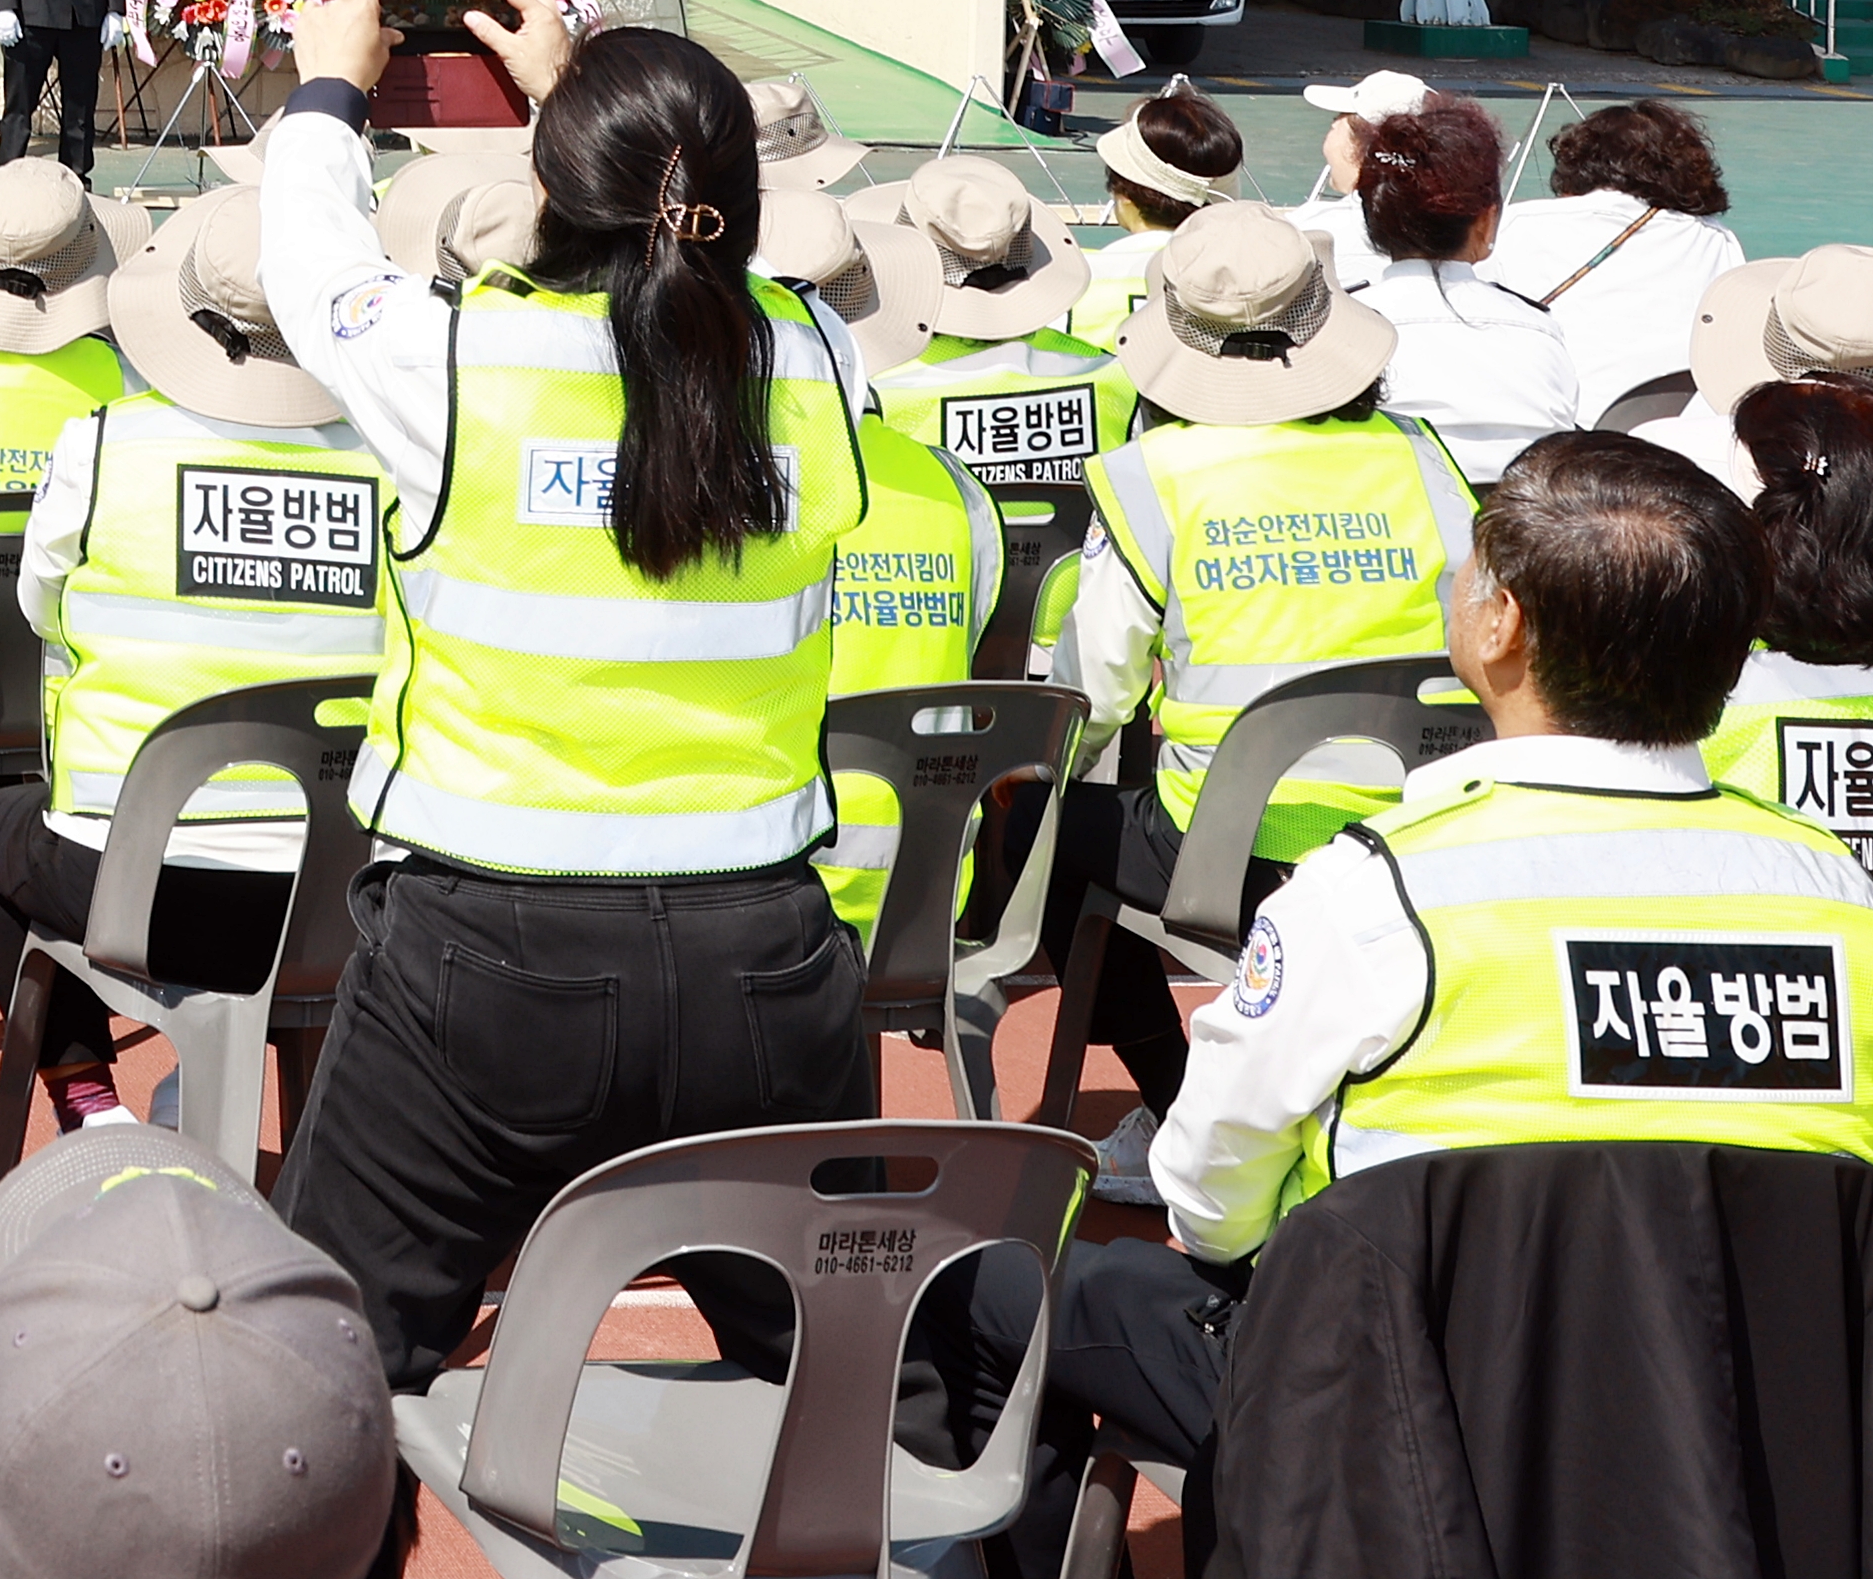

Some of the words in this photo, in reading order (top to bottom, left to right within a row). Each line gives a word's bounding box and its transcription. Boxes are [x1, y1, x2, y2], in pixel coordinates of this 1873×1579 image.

[954, 397, 1084, 456] 자율방범
[540, 453, 618, 511] 자율
[1032, 456, 1086, 480] PATRO
[192, 483, 363, 554] 자율방범
[1203, 511, 1391, 549] 화순안전지킴이
[192, 554, 283, 589] CITIZENS
[290, 563, 365, 597] PATROL
[1194, 548, 1419, 592] 여성자율방범대
[916, 755, 979, 773] 마라톤세상
[1795, 740, 1873, 818] 자율
[1585, 965, 1832, 1066] 자율방범
[818, 1229, 917, 1254] 마라톤세상
[814, 1254, 914, 1275] 010-4661-6212
